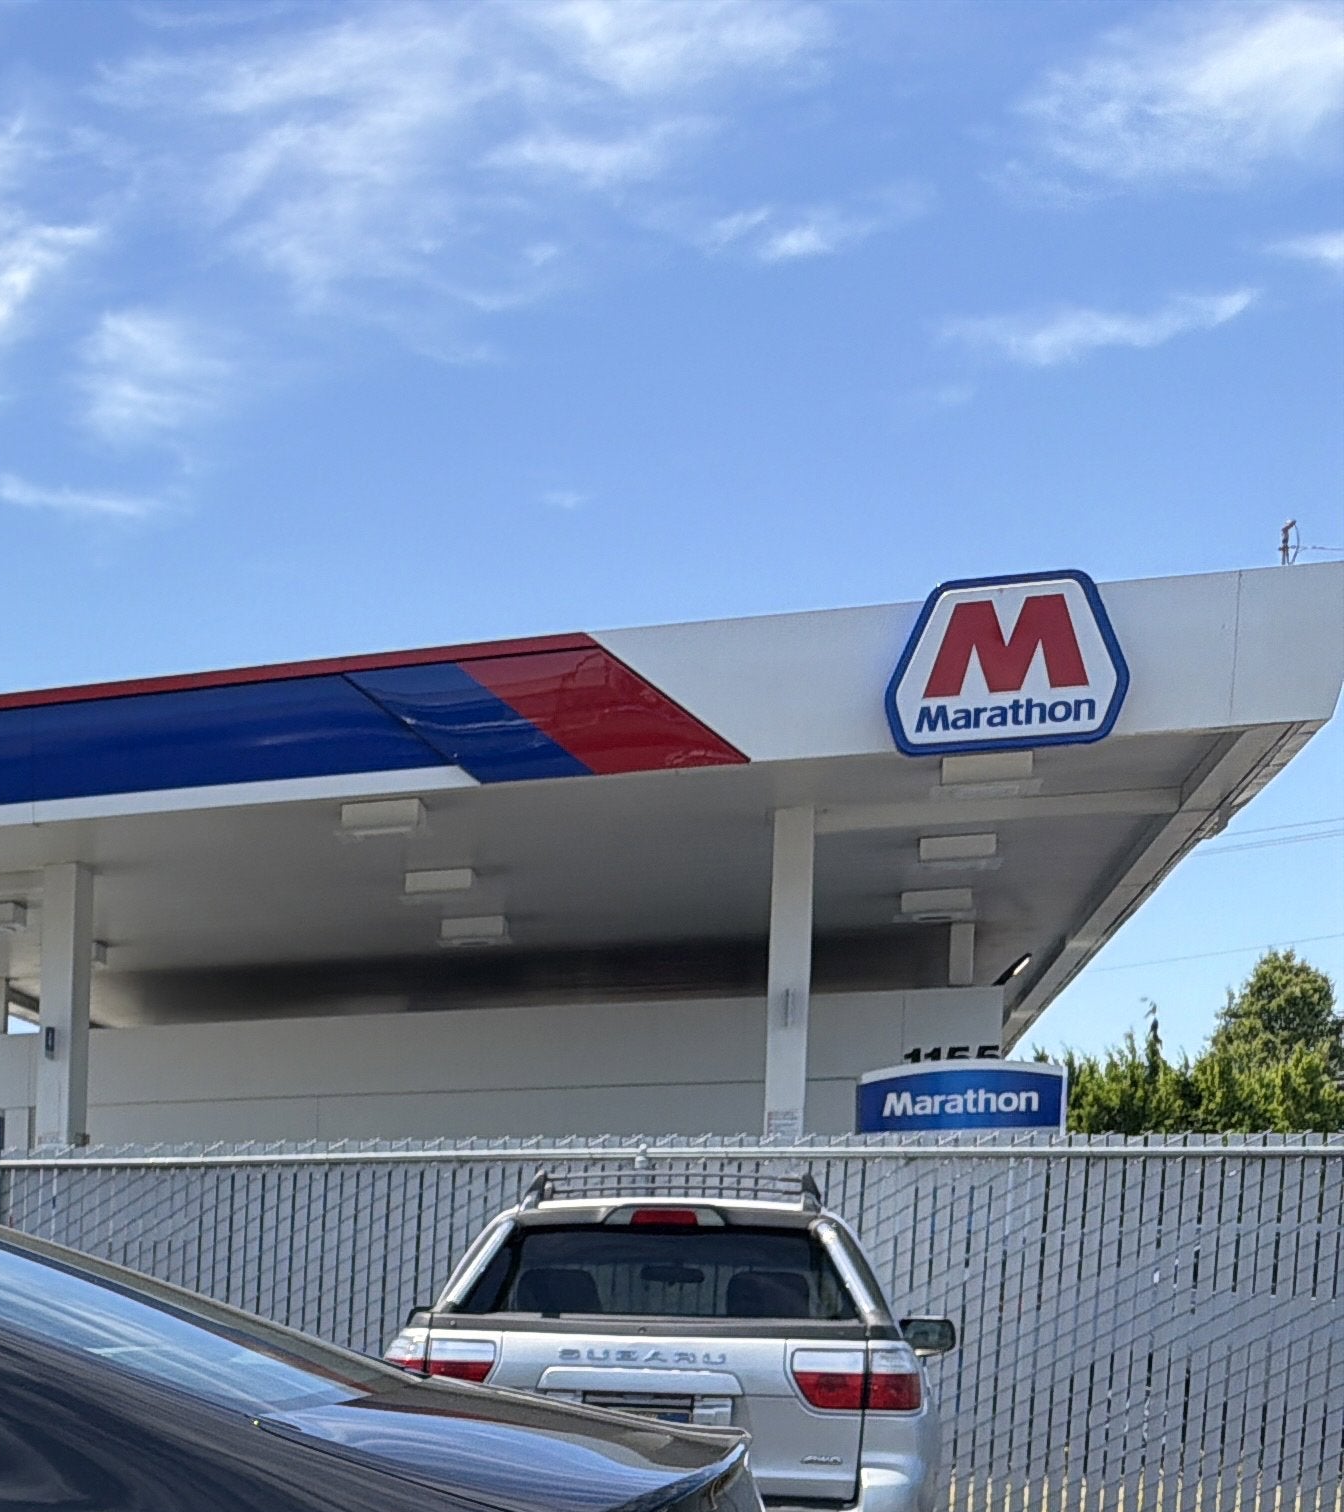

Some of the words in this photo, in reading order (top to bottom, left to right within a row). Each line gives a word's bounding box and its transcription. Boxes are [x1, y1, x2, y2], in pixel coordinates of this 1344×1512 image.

[915, 697, 1096, 733] Marathon
[882, 1088, 1040, 1117] Marathon
[557, 1348, 727, 1365] SUBARU
